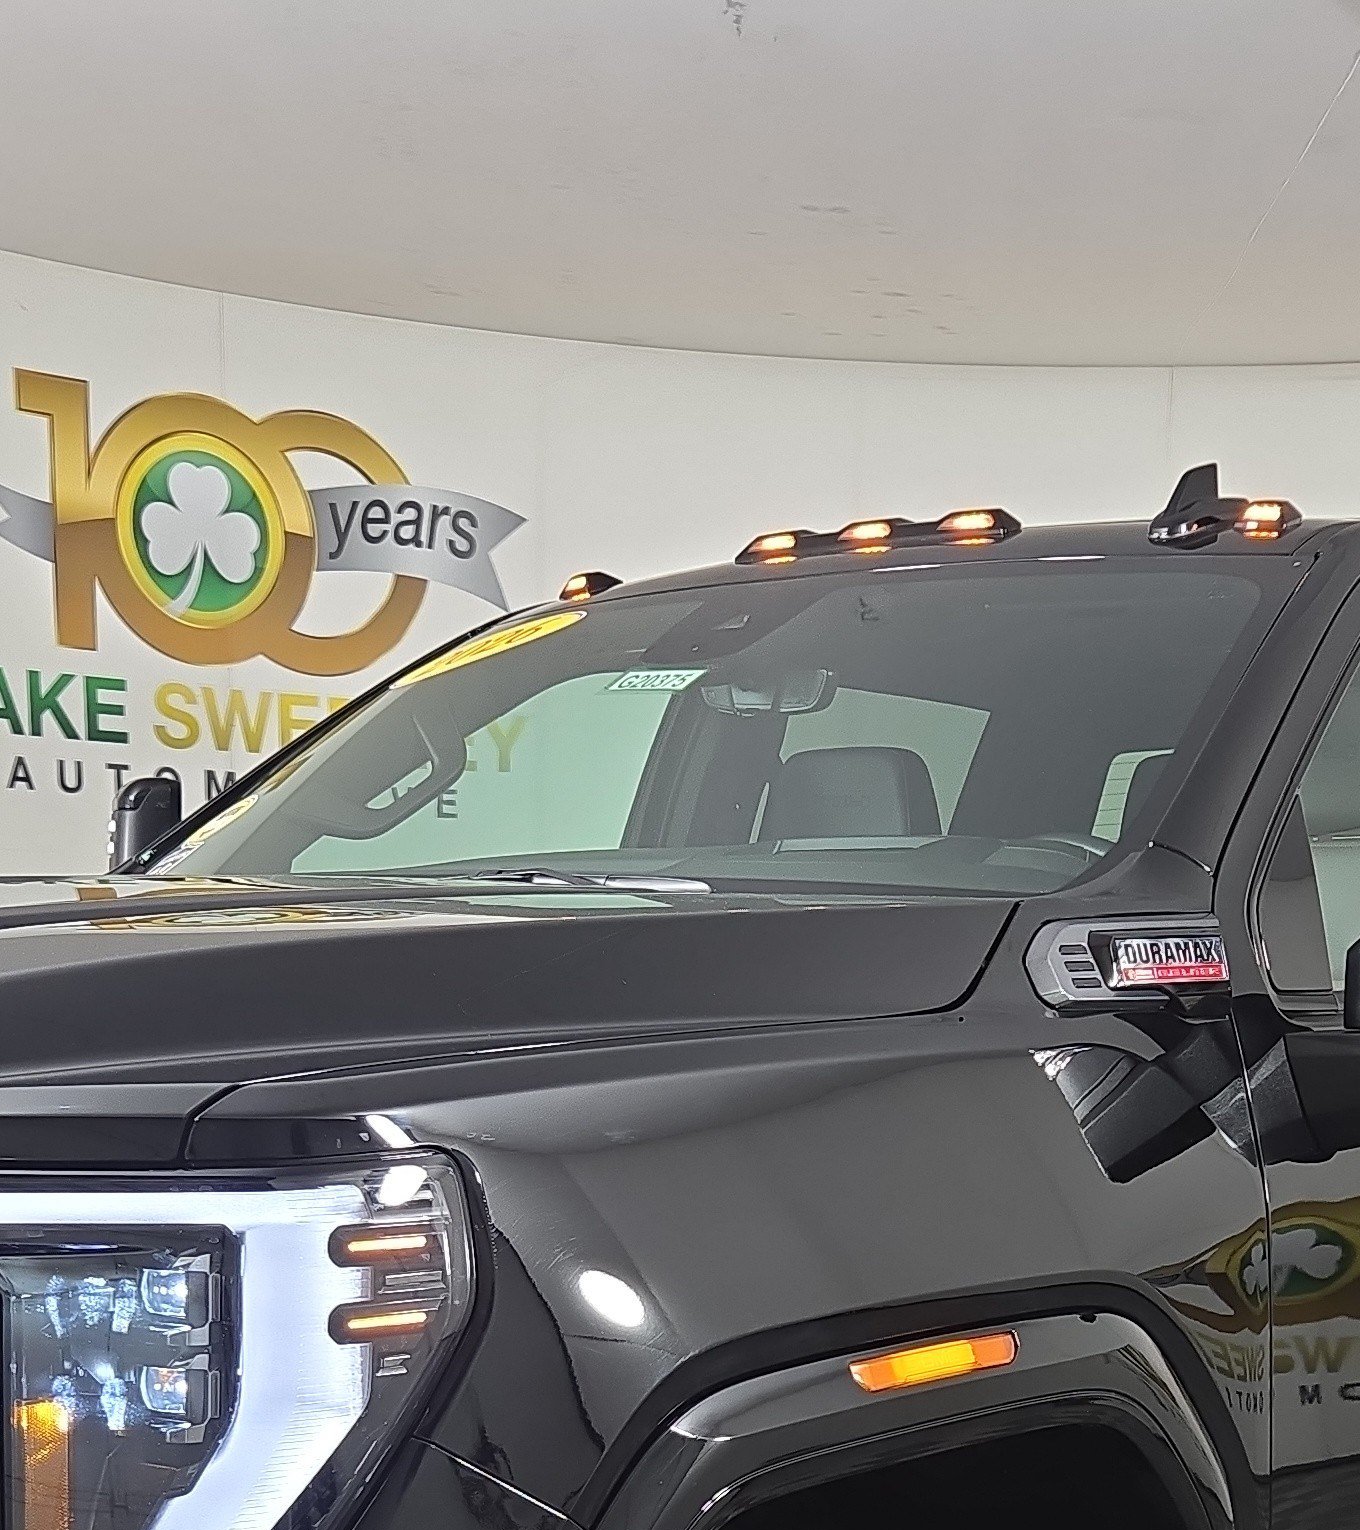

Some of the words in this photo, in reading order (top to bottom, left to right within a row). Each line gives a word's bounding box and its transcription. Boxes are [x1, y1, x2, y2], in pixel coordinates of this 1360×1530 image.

[328, 496, 480, 561] years
[617, 673, 695, 689] G20375
[1123, 939, 1223, 965] DURAMAX
